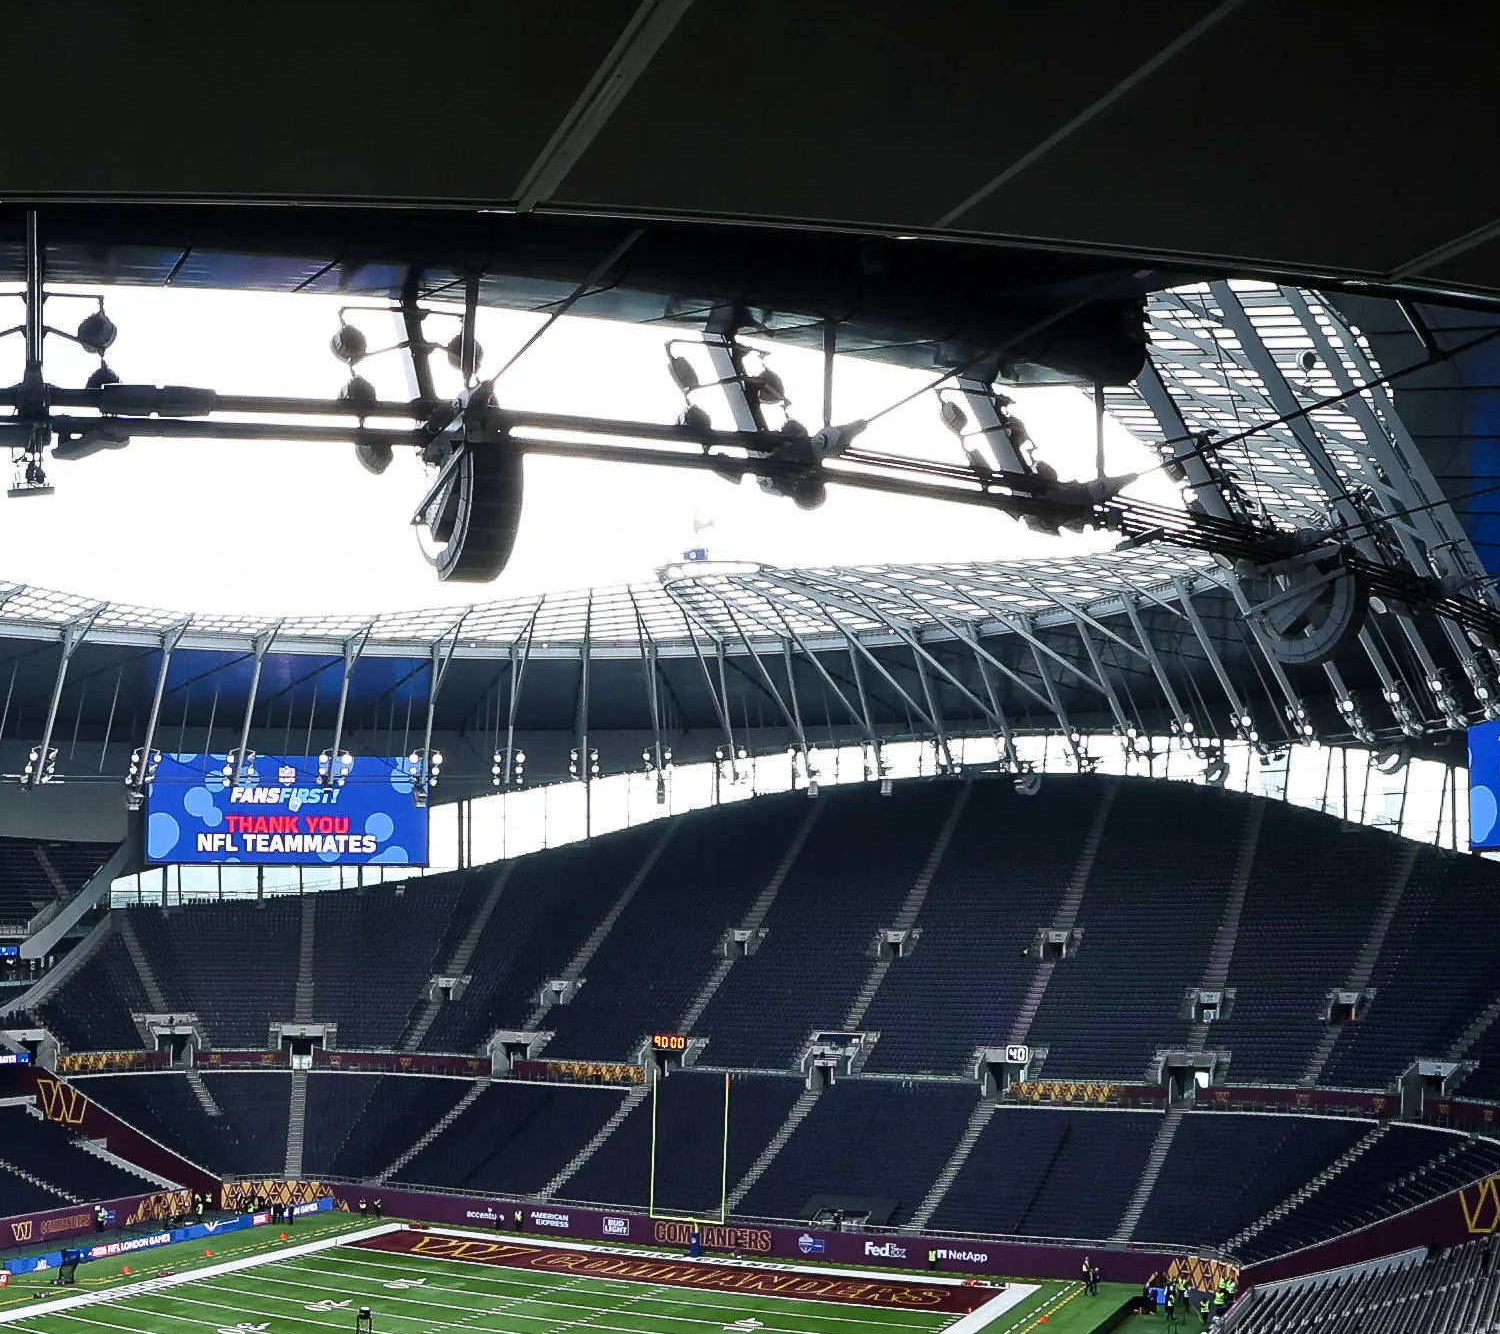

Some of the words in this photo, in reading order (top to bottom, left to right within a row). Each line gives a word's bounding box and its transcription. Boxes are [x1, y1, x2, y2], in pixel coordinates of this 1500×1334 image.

[225, 815, 299, 834] THANK
[305, 815, 351, 834] YOU
[197, 834, 240, 852] NFL
[243, 834, 377, 854] TEAMMATES
[467, 1209, 505, 1221] accentue
[531, 1211, 569, 1222] AMERICAN
[607, 1217, 625, 1226] BUD
[535, 1219, 569, 1228] EXPRESS
[605, 1225, 628, 1234] LIGHT
[655, 1222, 772, 1251] COMANDERS
[864, 1241, 907, 1259] FedEx
[949, 1250, 988, 1264] NetApp
[722, 1319, 765, 1334] 10
